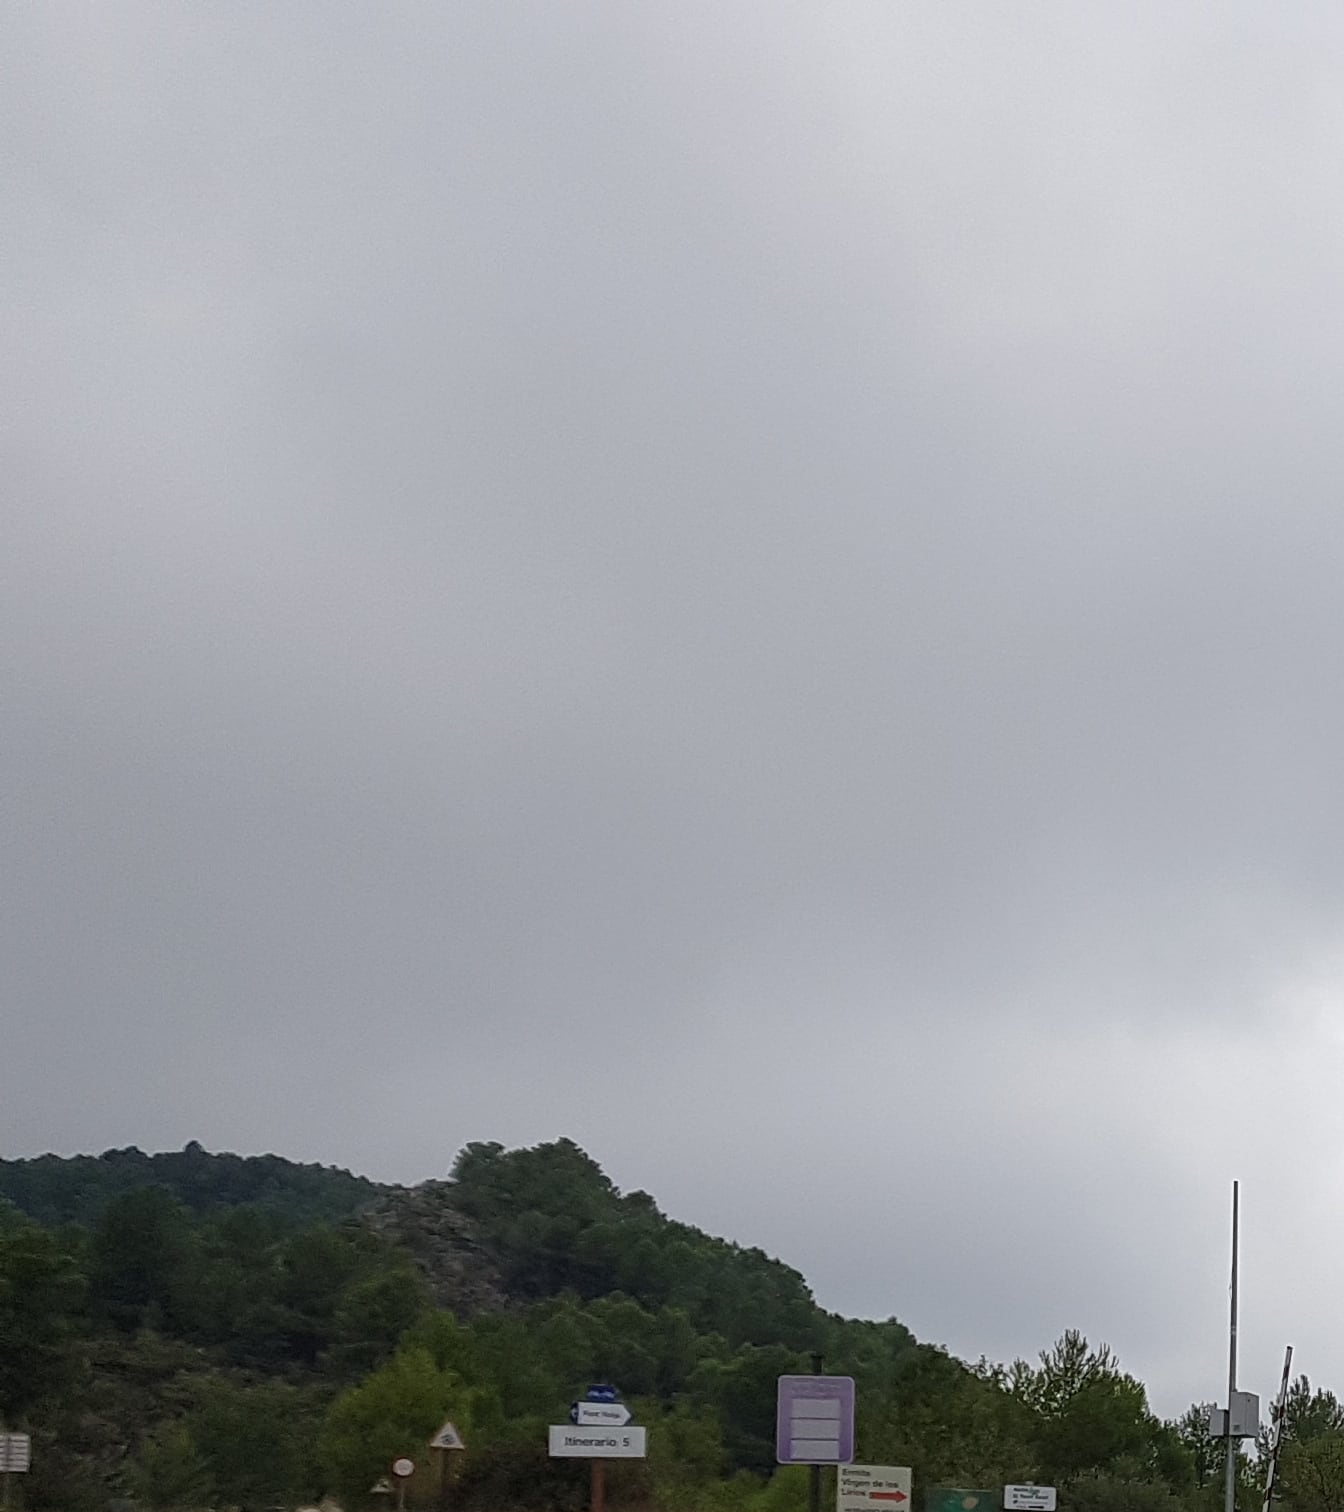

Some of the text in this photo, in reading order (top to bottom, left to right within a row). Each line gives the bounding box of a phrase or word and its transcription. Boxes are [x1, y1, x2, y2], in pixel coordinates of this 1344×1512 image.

[564, 1437, 630, 1447] Itinerario 5
[841, 1479, 871, 1487] Virgen
